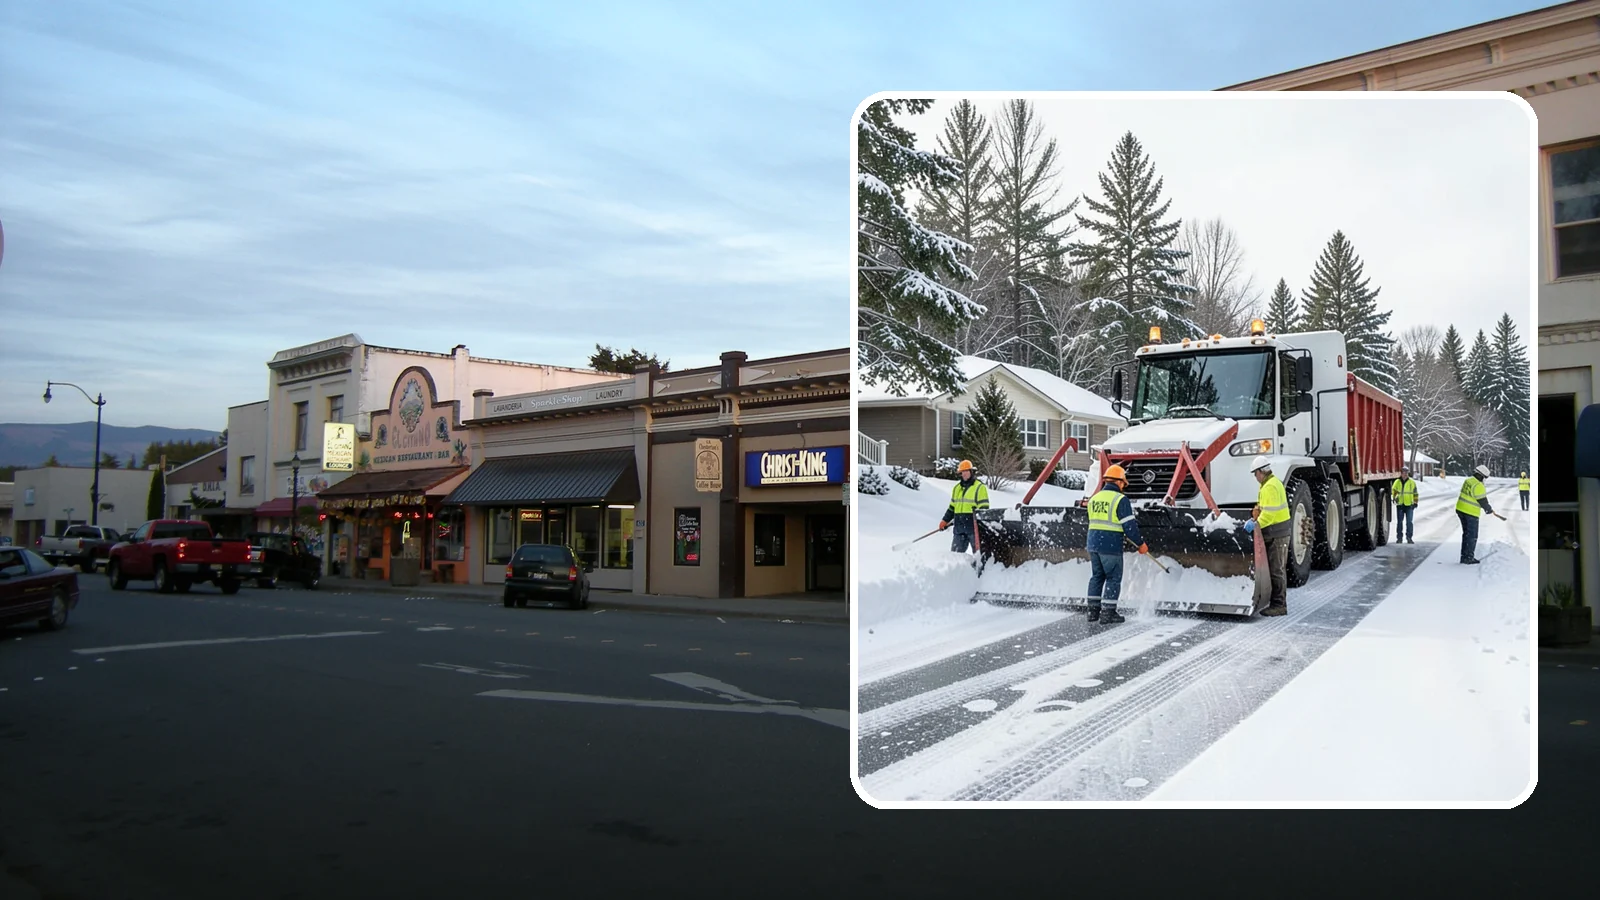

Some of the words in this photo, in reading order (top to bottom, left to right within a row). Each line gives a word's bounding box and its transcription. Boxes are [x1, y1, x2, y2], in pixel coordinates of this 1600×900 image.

[595, 389, 624, 400] LAUNDRY
[531, 397, 561, 409] Sparkle
[562, 394, 582, 405] Shop
[493, 402, 522, 413] LAVANDERIA
[397, 451, 434, 462] RESTAURANT
[438, 450, 450, 459] BAR
